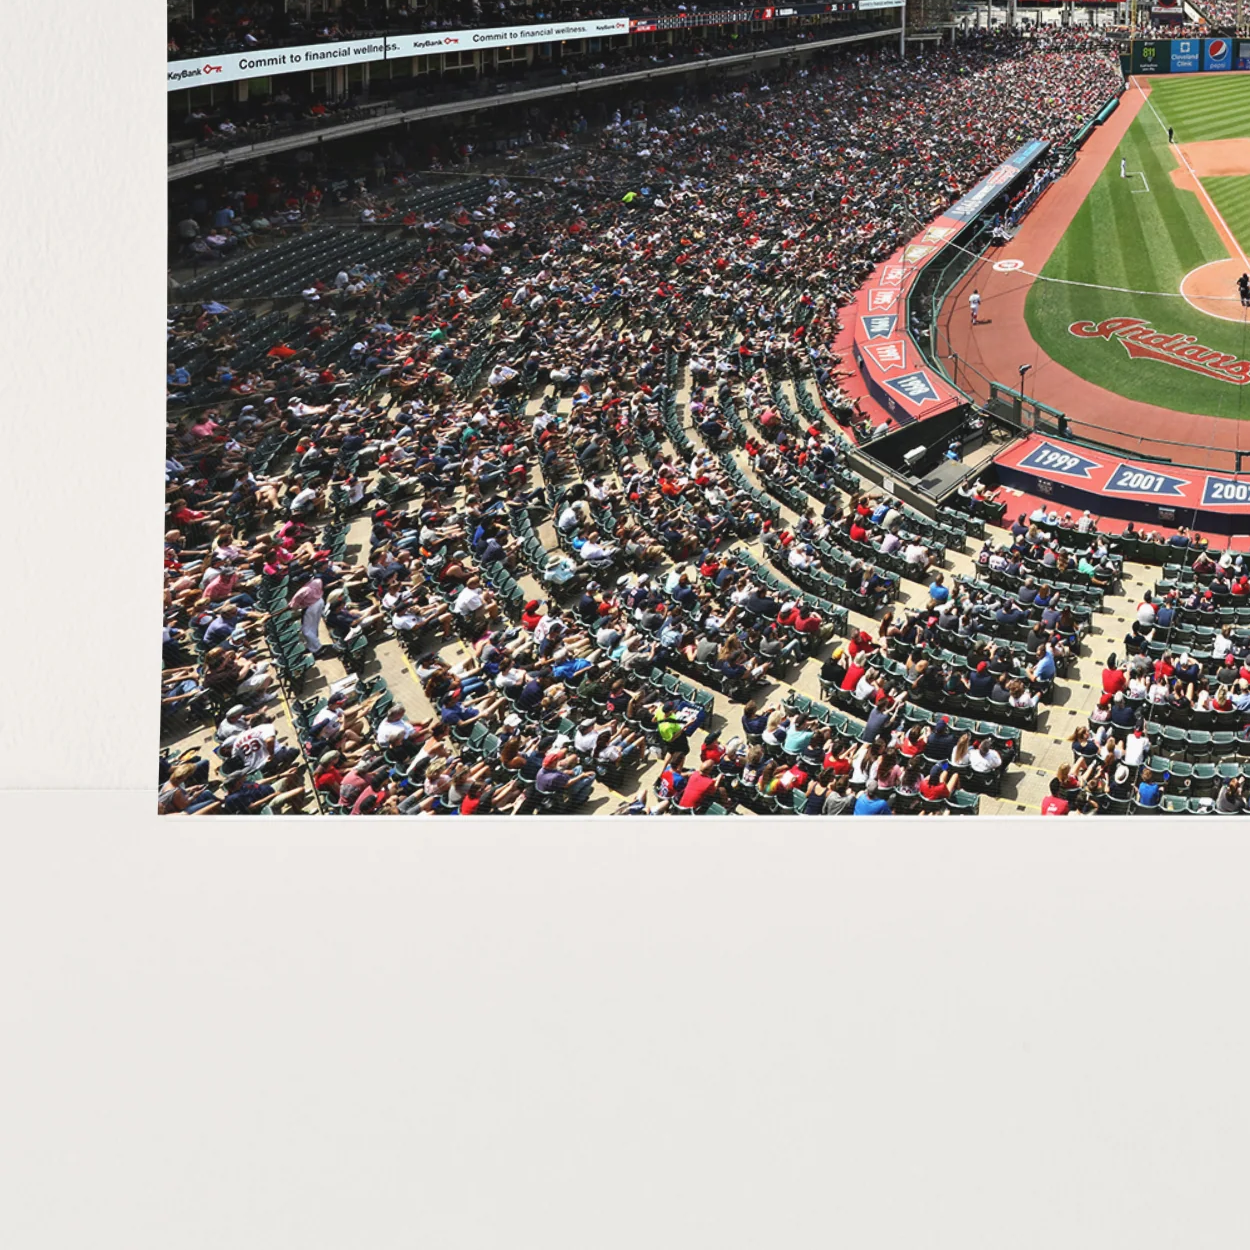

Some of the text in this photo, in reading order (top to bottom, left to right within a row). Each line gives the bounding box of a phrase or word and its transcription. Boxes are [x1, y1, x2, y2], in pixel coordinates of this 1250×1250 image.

[472, 25, 587, 43] Commit to financial wellness.
[414, 39, 442, 48] KeyBank
[239, 43, 401, 70] Commit to financial wellness.
[1176, 60, 1193, 68] Clinic
[167, 67, 202, 81] KeyBank
[1034, 449, 1081, 471] 1999
[1116, 470, 1165, 492] 2001
